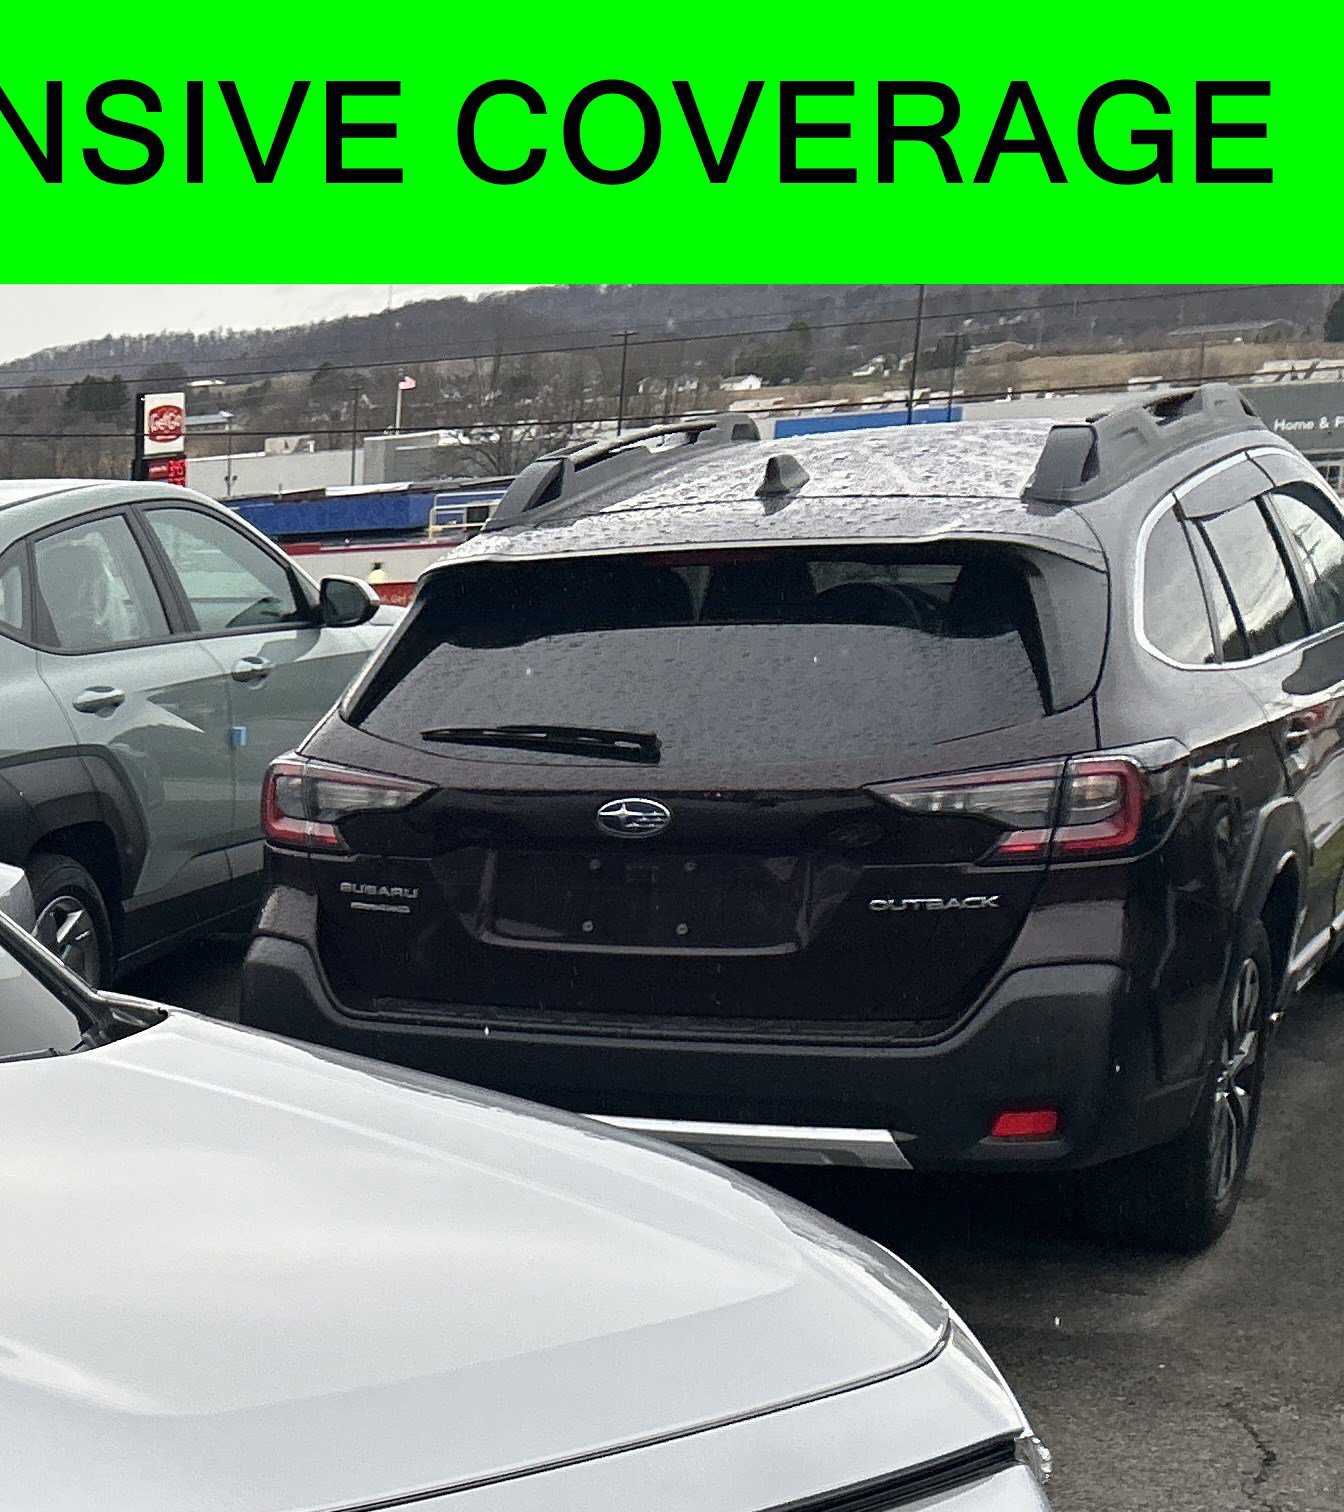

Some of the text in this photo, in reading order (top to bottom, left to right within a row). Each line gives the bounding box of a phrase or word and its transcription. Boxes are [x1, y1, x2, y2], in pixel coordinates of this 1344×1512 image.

[1274, 418, 1314, 431] Home
[340, 881, 420, 899] SUBARU
[869, 895, 1001, 911] OUTBACK
